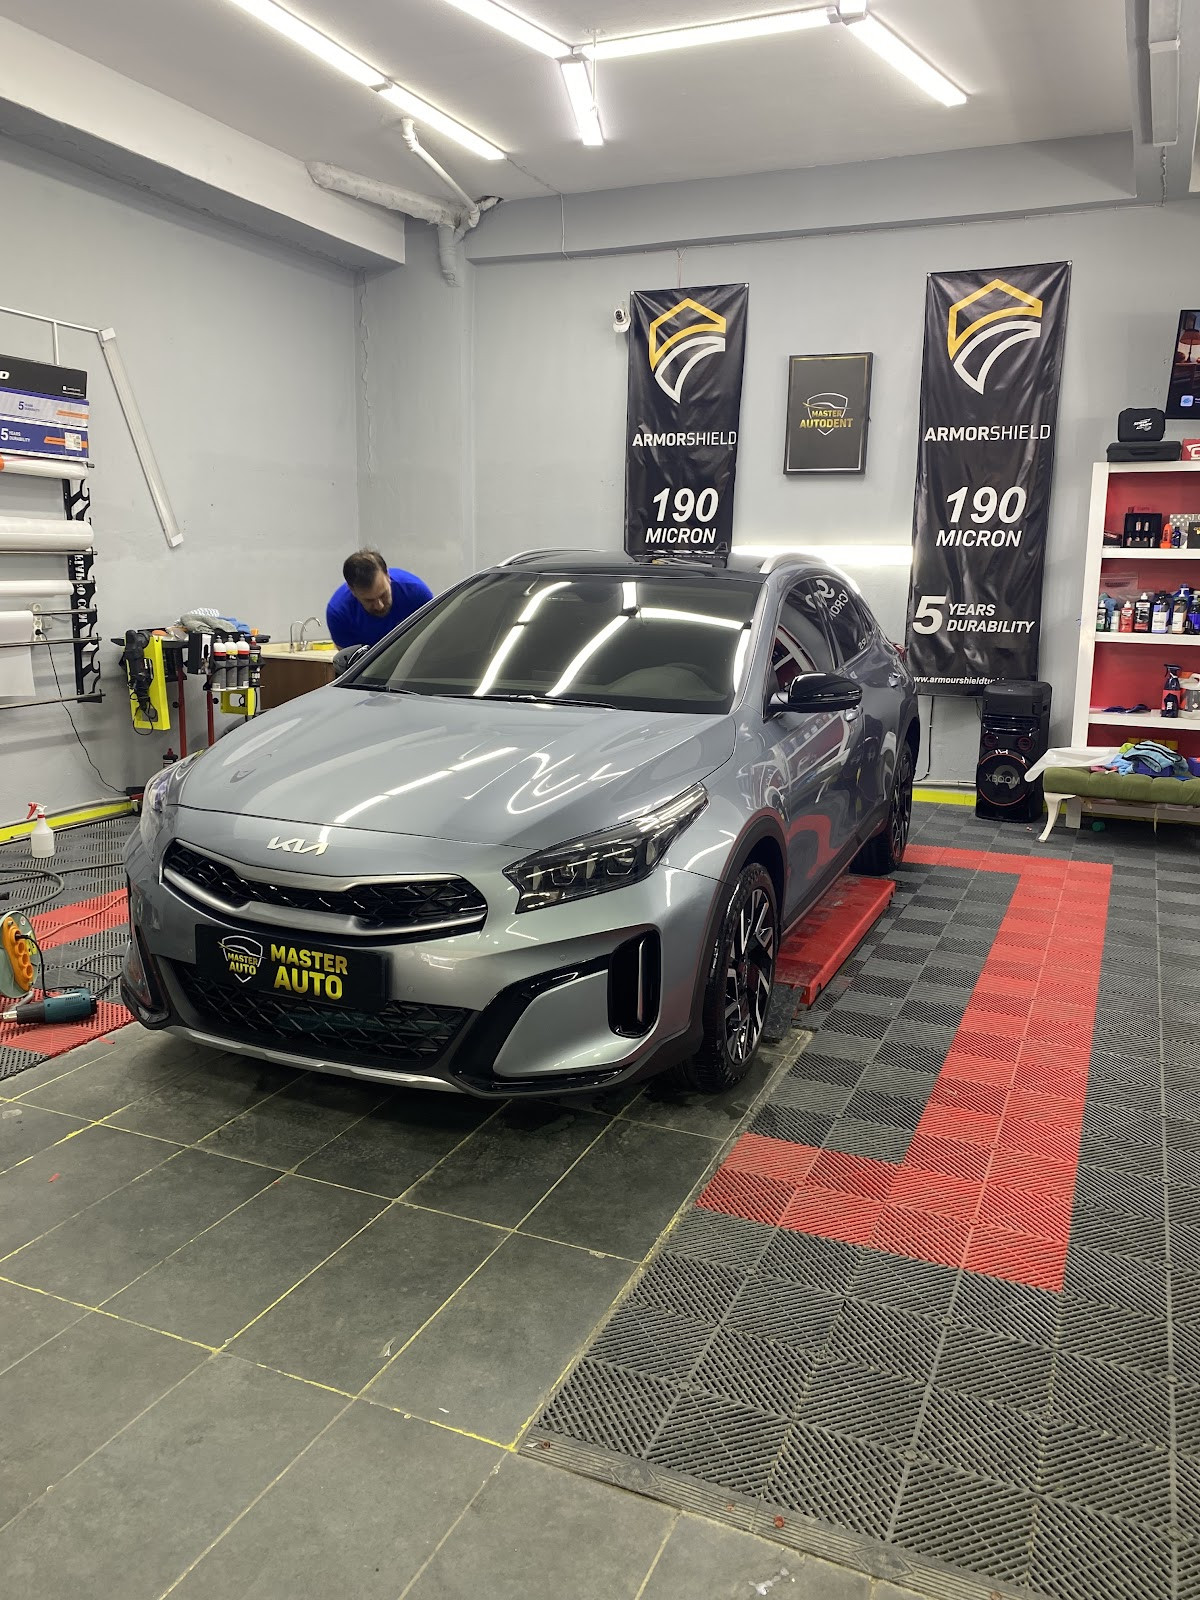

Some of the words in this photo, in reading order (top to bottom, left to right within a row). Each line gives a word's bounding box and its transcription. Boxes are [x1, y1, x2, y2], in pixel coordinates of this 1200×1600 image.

[18, 401, 25, 410] 5
[800, 418, 853, 428] AUTODENT
[1, 427, 9, 441] 5
[632, 431, 737, 446] ARMORSHIELD
[924, 424, 1051, 442] ARMORSHIELD
[653, 487, 719, 522] 190
[946, 486, 1027, 524] 190
[645, 527, 717, 543] MICRON
[935, 529, 1022, 547] MICRON
[912, 595, 947, 634] 5
[948, 603, 996, 616] YEARS
[946, 620, 1035, 633] DURABILITY
[985, 774, 1020, 784] XBOOM
[266, 835, 329, 856] KIA
[227, 952, 258, 966] MASTER
[270, 943, 348, 975] MASTER
[228, 961, 257, 975] AUTO
[273, 965, 343, 1000] AUTO
